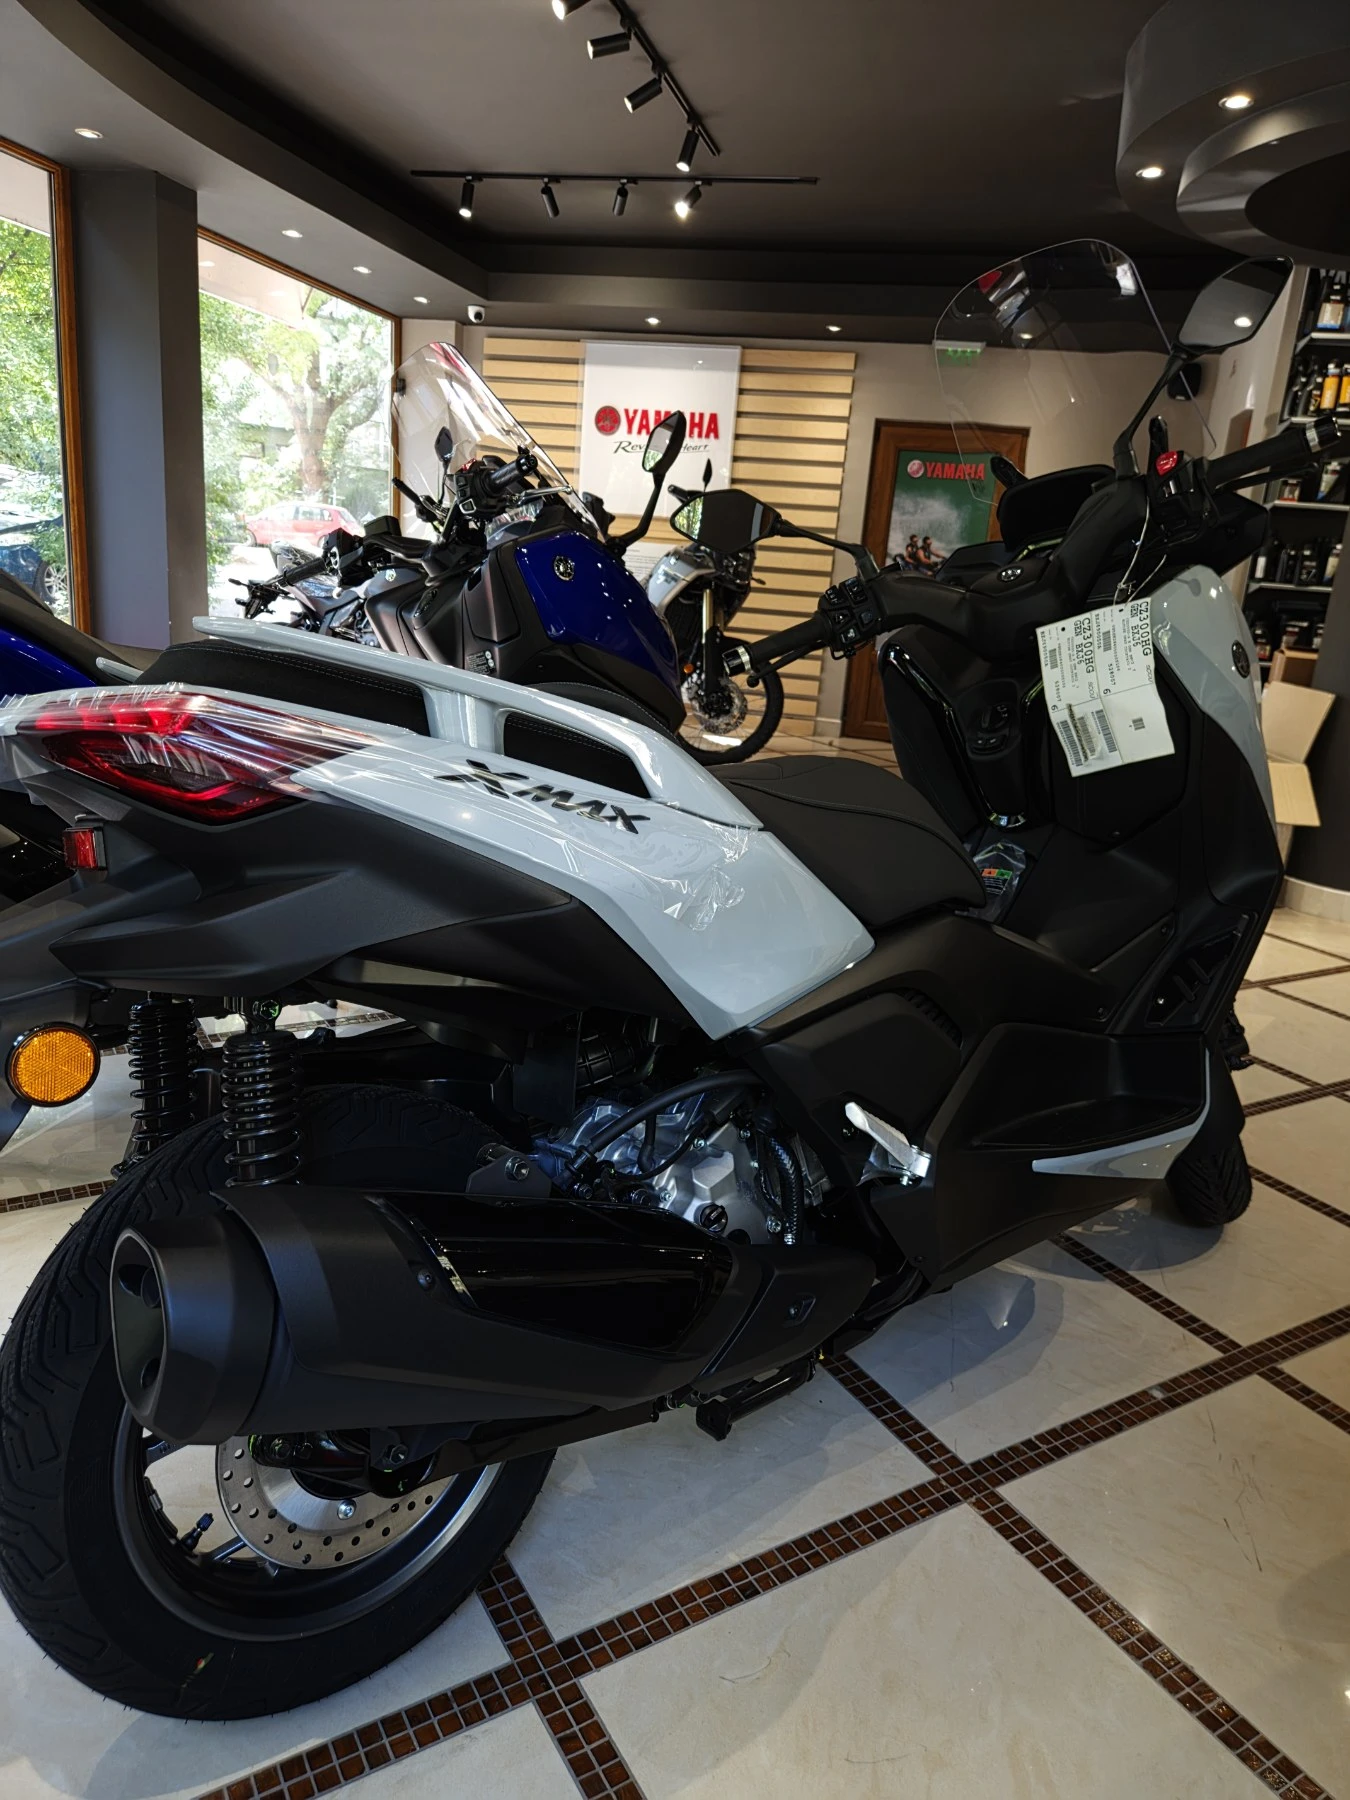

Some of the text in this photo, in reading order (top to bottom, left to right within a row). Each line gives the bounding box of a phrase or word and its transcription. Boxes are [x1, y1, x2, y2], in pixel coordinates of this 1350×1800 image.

[624, 408, 719, 440] YAHA
[613, 440, 646, 453] Rev
[926, 462, 985, 480] YAMAHA
[1130, 603, 1139, 619] GEN
[1073, 619, 1082, 637] GEN
[1139, 601, 1152, 657] CZ300HG
[1081, 617, 1095, 674] CZ300HG
